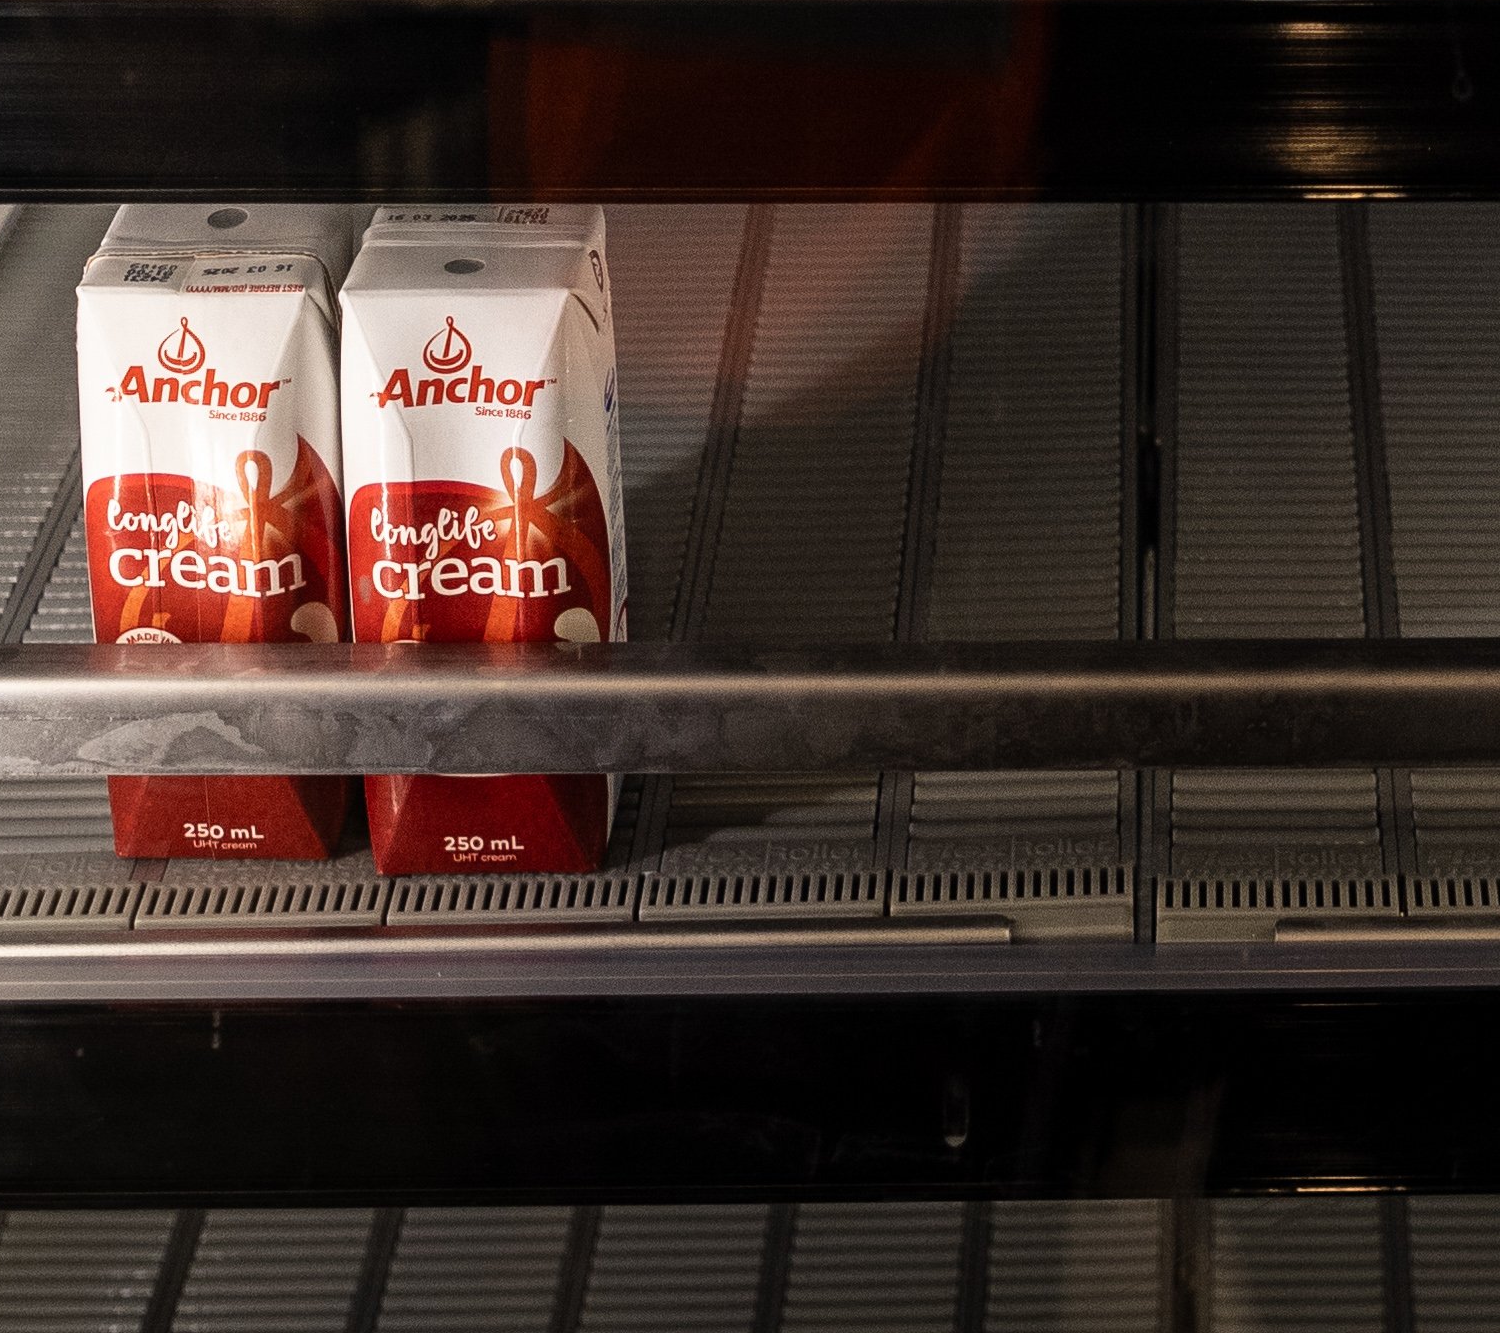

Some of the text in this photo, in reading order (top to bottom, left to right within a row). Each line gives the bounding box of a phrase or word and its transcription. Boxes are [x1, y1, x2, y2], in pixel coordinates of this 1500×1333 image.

[248, 284, 280, 293] BEFORE
[282, 284, 304, 293] BEST
[112, 365, 281, 409] Anchor
[378, 365, 545, 409] Anchor
[208, 409, 266, 422] Since 1886
[475, 406, 532, 421] Since 1886
[107, 498, 232, 553] longlife
[370, 503, 497, 558] longlife
[108, 545, 307, 599] cream
[371, 556, 572, 602] cream
[183, 823, 264, 840] 250 mL
[193, 839, 257, 851] UHT cream
[443, 835, 525, 851] 250 mL
[452, 852, 517, 863] UHT cream
